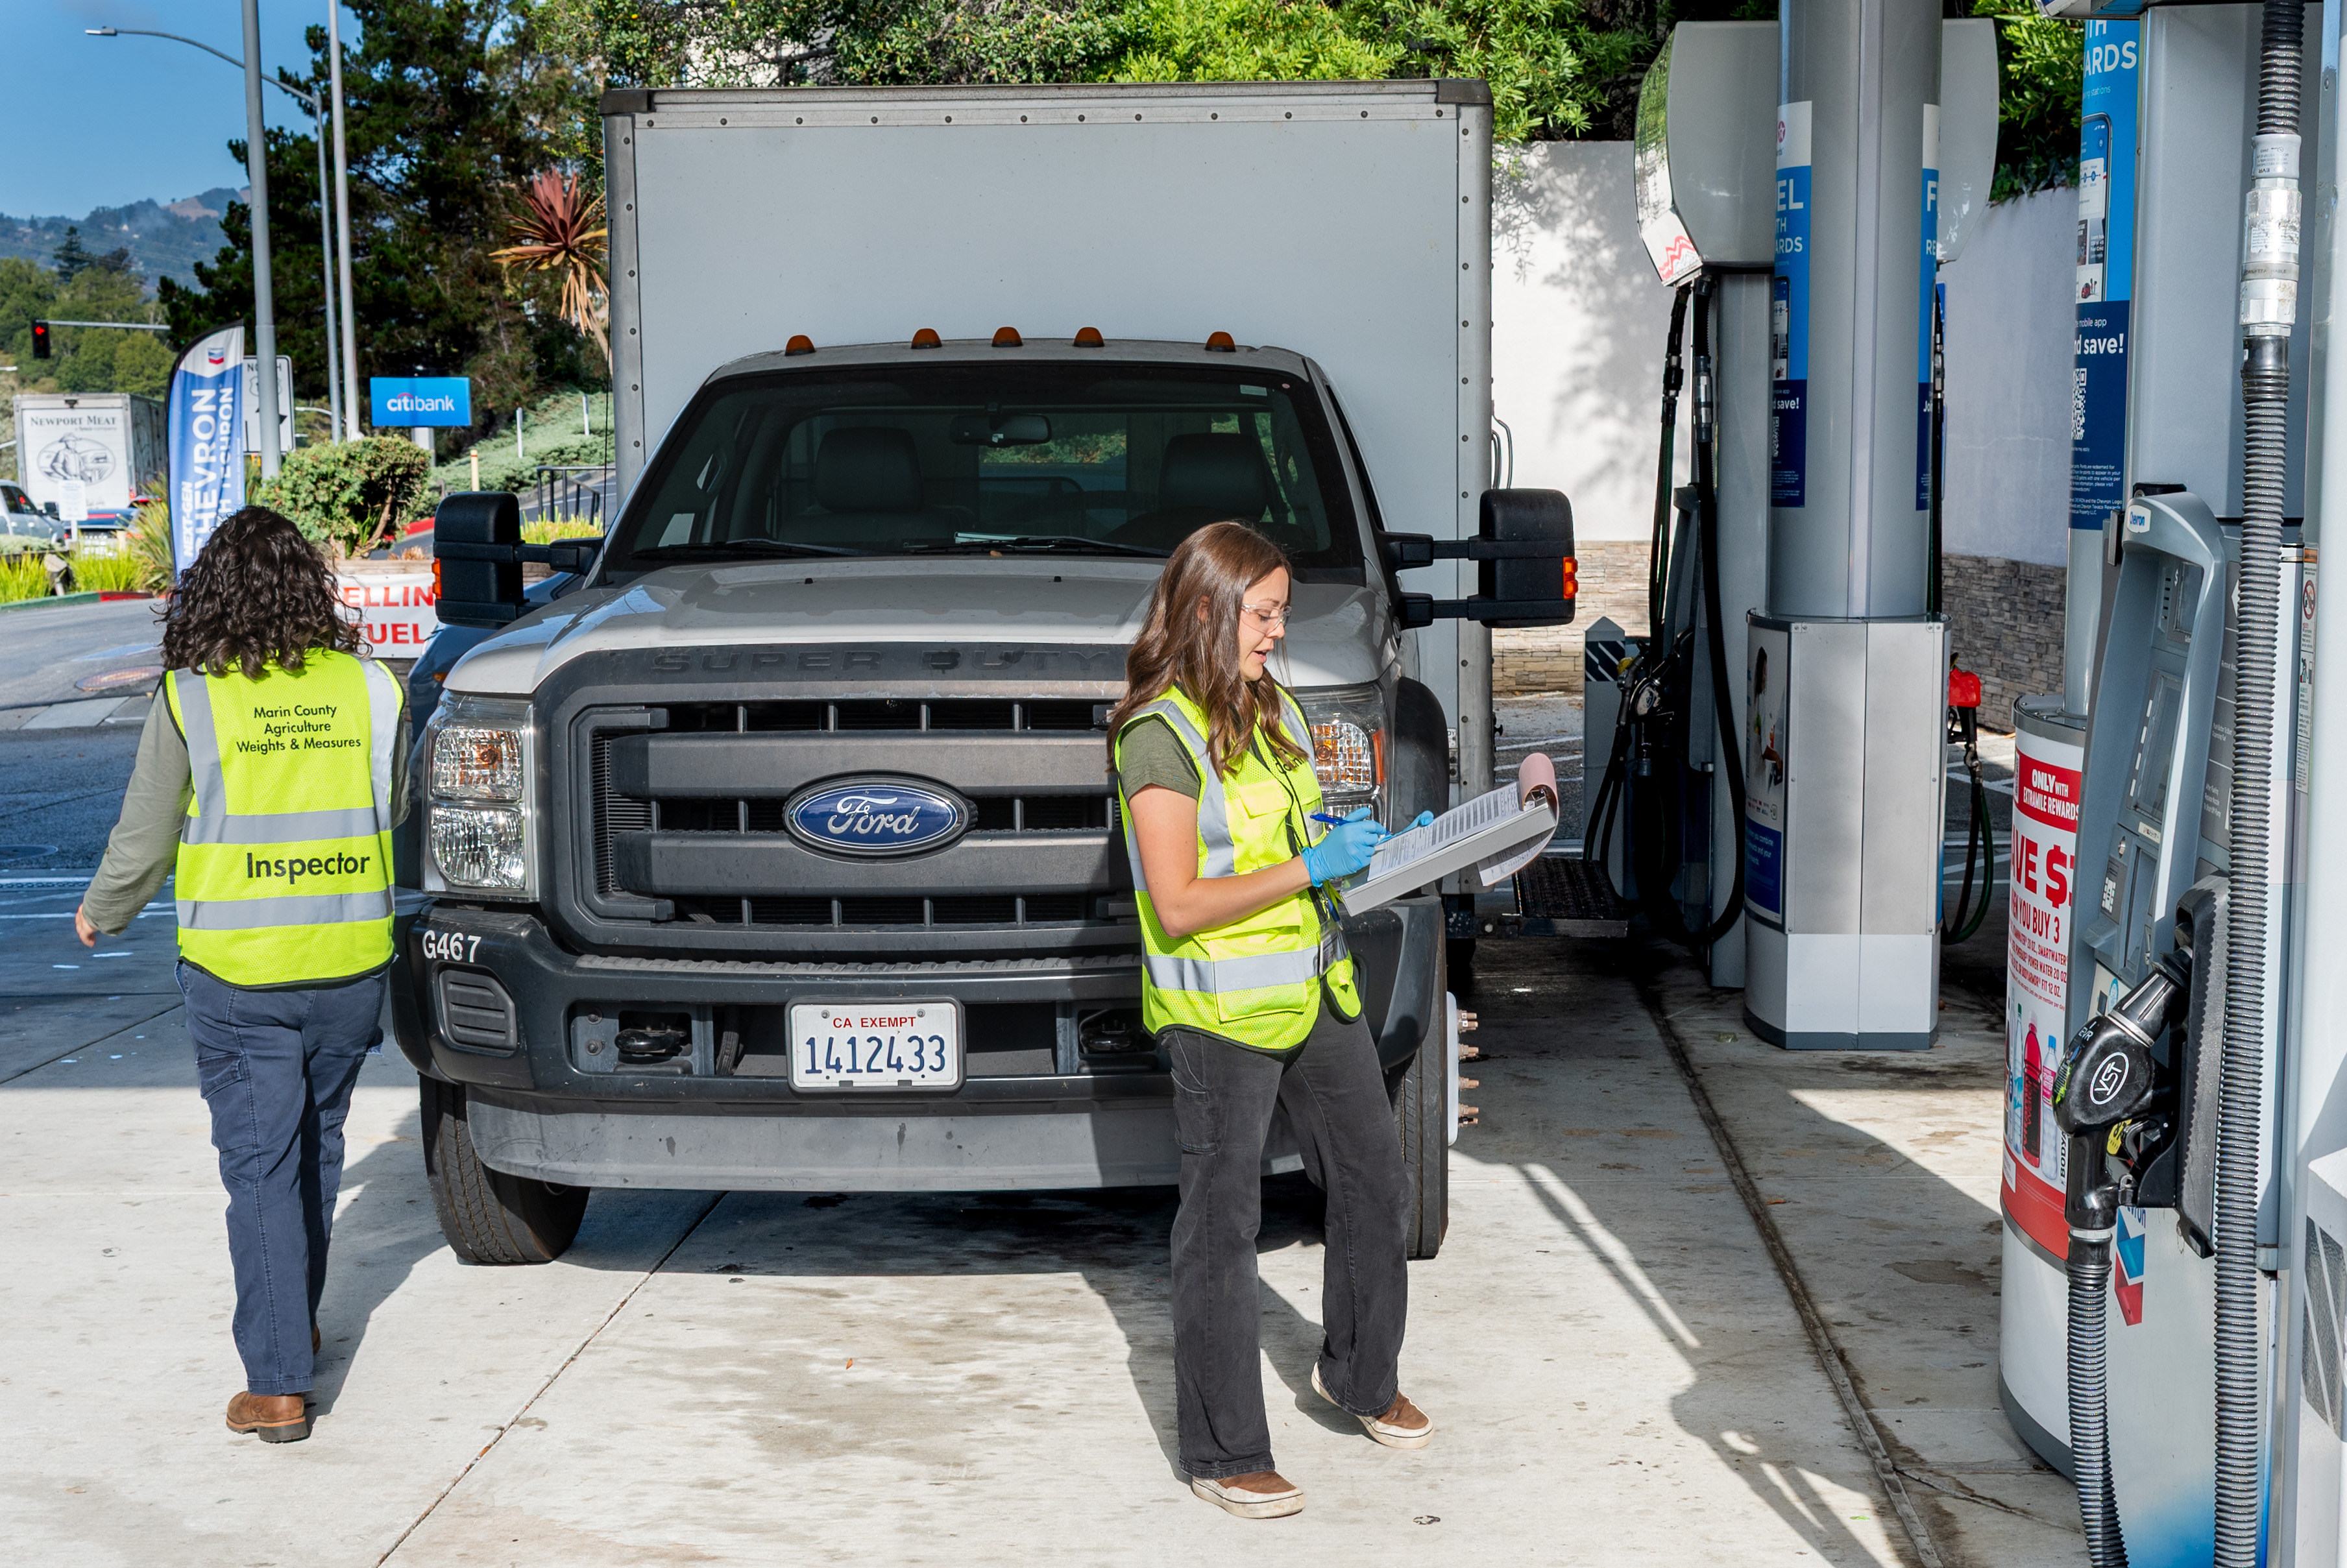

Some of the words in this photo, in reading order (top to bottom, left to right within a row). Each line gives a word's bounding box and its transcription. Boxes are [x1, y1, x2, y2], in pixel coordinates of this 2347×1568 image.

[2094, 319, 2107, 328] app
[2084, 333, 2124, 354] save!
[387, 393, 455, 412] citibank
[1777, 398, 1799, 409] save!
[30, 416, 83, 427] NEWPORT
[87, 415, 116, 426] MEAT
[182, 481, 194, 557] NEXT-GEN
[334, 586, 434, 607] ELLIN
[349, 623, 426, 644] UEL
[650, 649, 884, 673] SUPER
[920, 649, 1110, 672] DUTY
[254, 707, 290, 718] Marin
[294, 705, 337, 718] County
[264, 721, 332, 736] Agriculture
[236, 741, 286, 754] Weights
[290, 738, 299, 749] &
[304, 738, 361, 749] Measures
[2032, 769, 2056, 793] ONLY
[2055, 781, 2069, 797] WITH
[2023, 786, 2047, 812] EXTRAMILE
[827, 795, 921, 835] Ford
[247, 852, 371, 884] Inspector
[2019, 897, 2031, 930] YOU
[2033, 906, 2050, 940] BUY
[2054, 916, 2060, 944] 3
[422, 930, 481, 963] G467
[2039, 961, 2053, 978] WATER
[2053, 968, 2060, 981] 20
[833, 1017, 853, 1028] CA
[860, 1017, 916, 1028] EXEMPT
[2078, 1027, 2094, 1041] EVR
[805, 1035, 946, 1076] 1412433
[2094, 1061, 2122, 1096] VST
